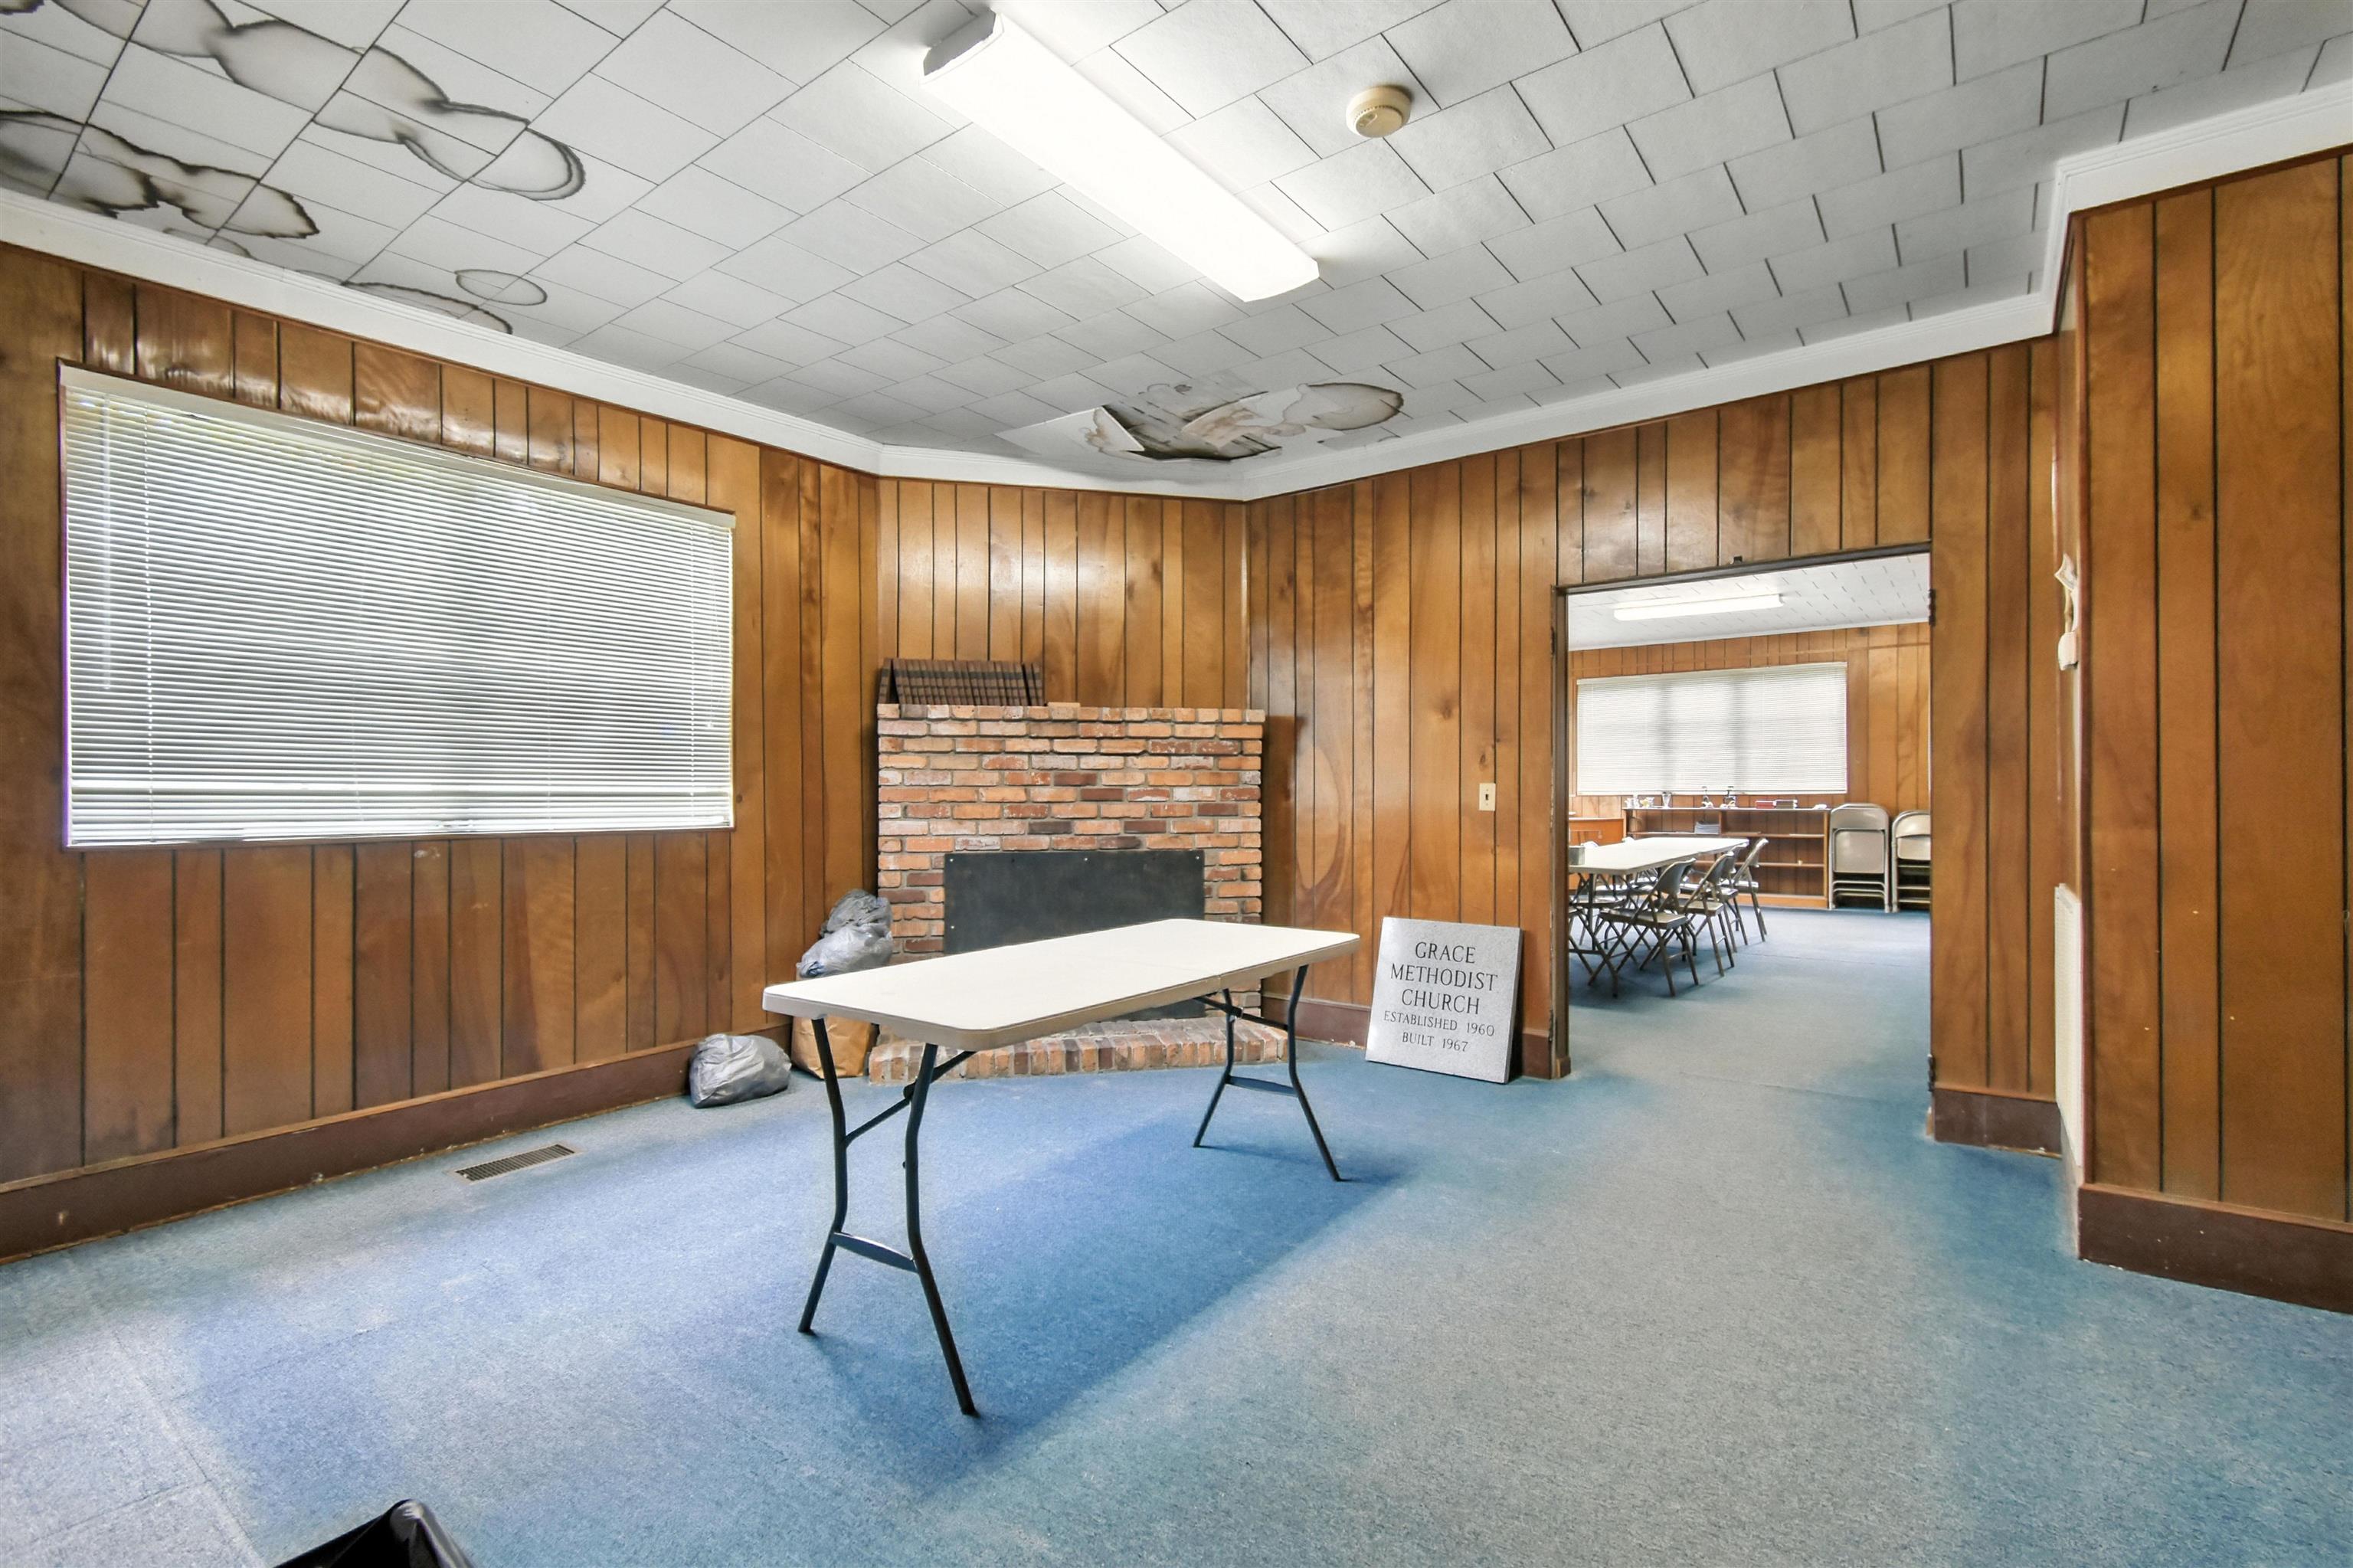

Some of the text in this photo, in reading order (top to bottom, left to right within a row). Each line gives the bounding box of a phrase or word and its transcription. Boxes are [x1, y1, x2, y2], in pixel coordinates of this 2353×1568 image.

[1415, 941, 1476, 964] GRACE
[1391, 963, 1498, 991] METHODIST
[1402, 989, 1480, 1015] CHURCH
[1384, 1010, 1494, 1036] ESTABLISHED 1960
[1402, 1032, 1468, 1052] BUILT 1967
